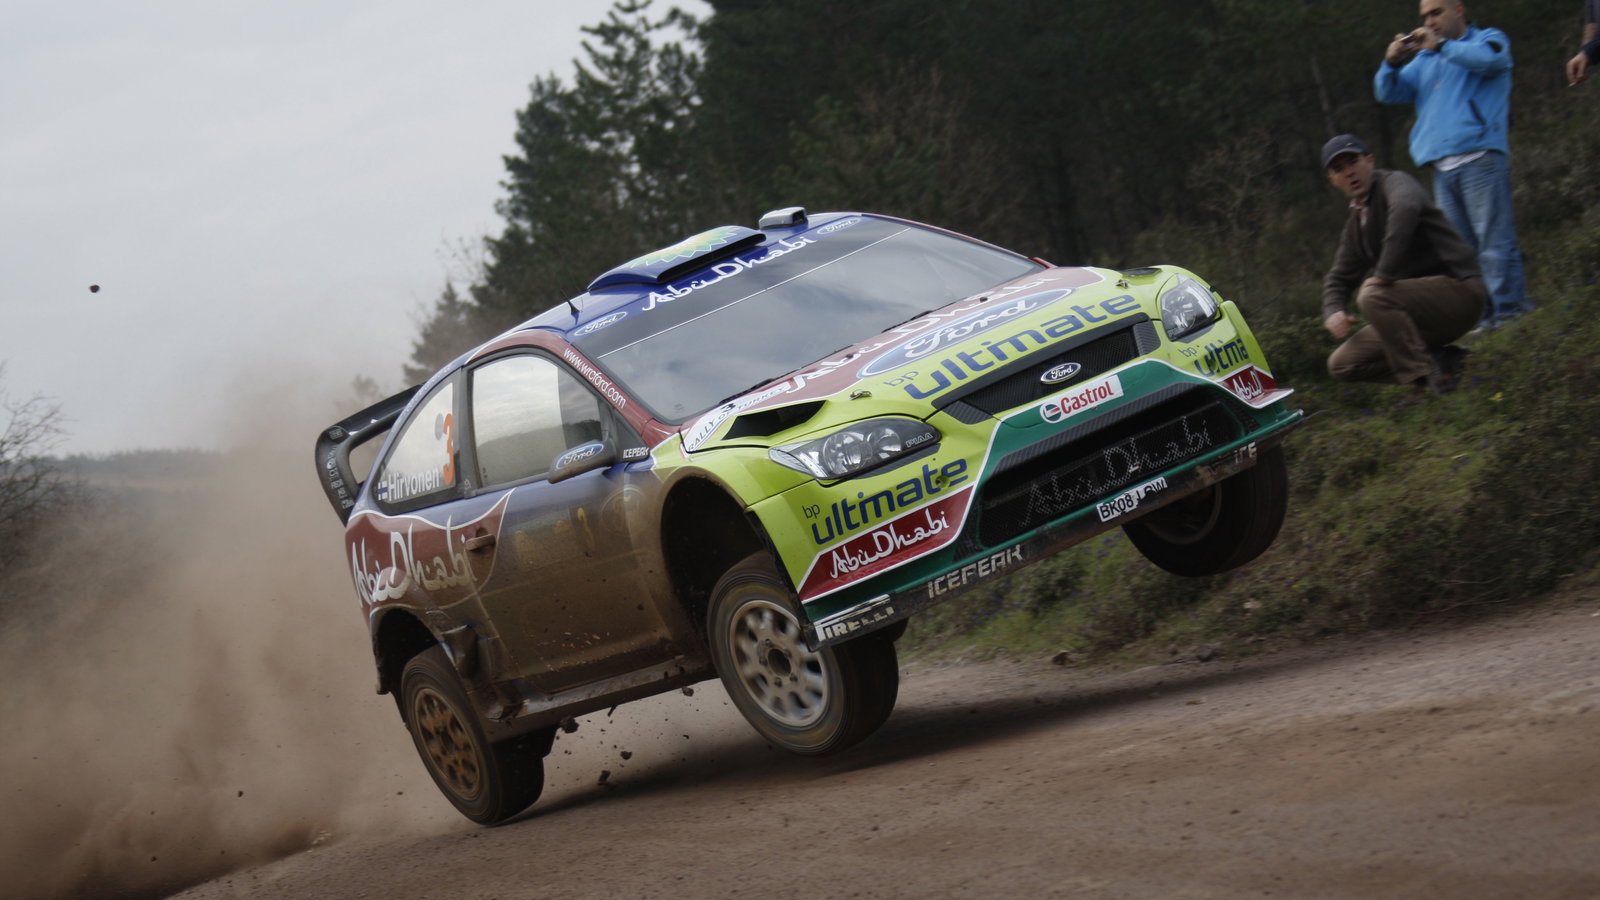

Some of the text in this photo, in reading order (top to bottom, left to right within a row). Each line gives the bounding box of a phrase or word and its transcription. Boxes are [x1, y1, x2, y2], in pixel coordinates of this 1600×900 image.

[904, 299, 1038, 358] Ford
[883, 293, 1142, 400] bp ultimate
[563, 348, 627, 408] www.wrcford.com
[1049, 364, 1075, 381] Ford
[721, 402, 737, 413] 3
[1060, 381, 1114, 415] Castrol
[443, 413, 455, 484] 3
[689, 419, 715, 452] RALLY
[906, 432, 933, 448] PIAA
[563, 447, 596, 466] Ford
[388, 466, 440, 501] Hirvonen
[802, 458, 968, 545] bp ultimate
[1100, 494, 1134, 519] BK08
